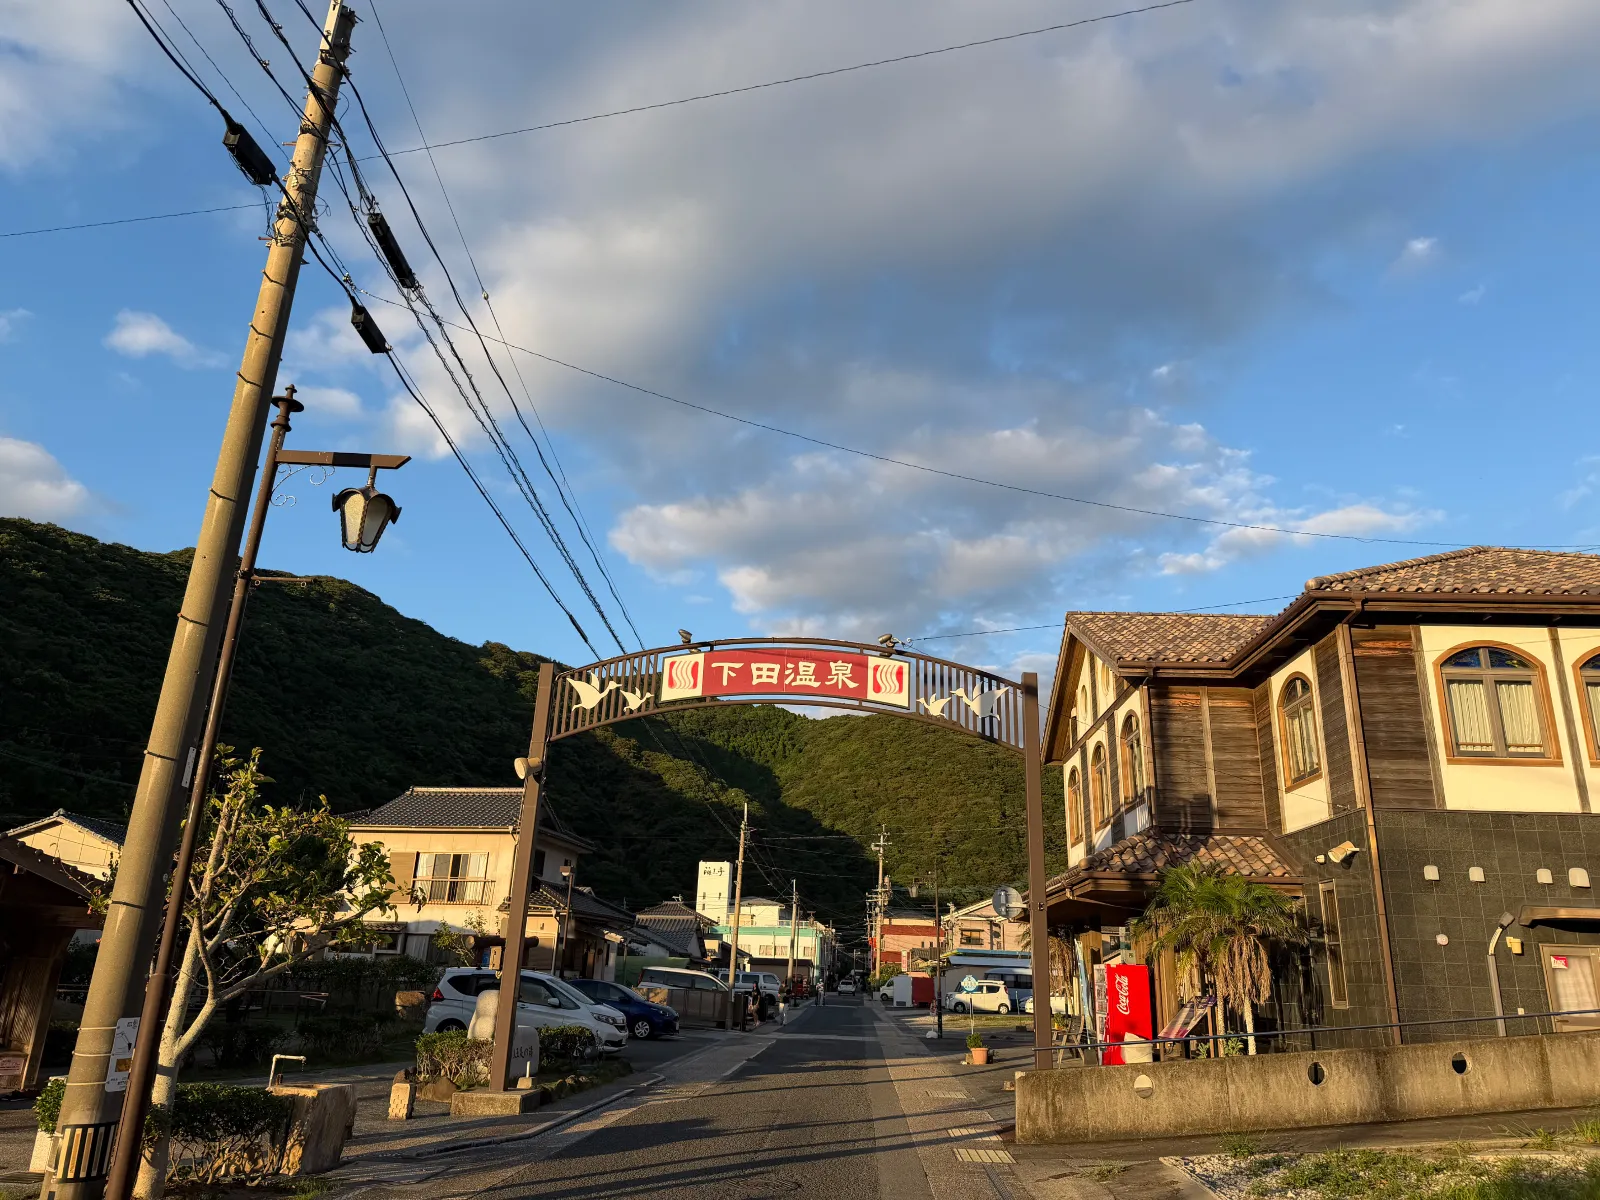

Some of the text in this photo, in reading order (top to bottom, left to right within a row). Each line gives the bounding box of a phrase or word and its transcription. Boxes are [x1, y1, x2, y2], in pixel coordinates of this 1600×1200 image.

[711, 660, 859, 689] 下田温泉
[1115, 973, 1130, 1015] Coca-Cola
